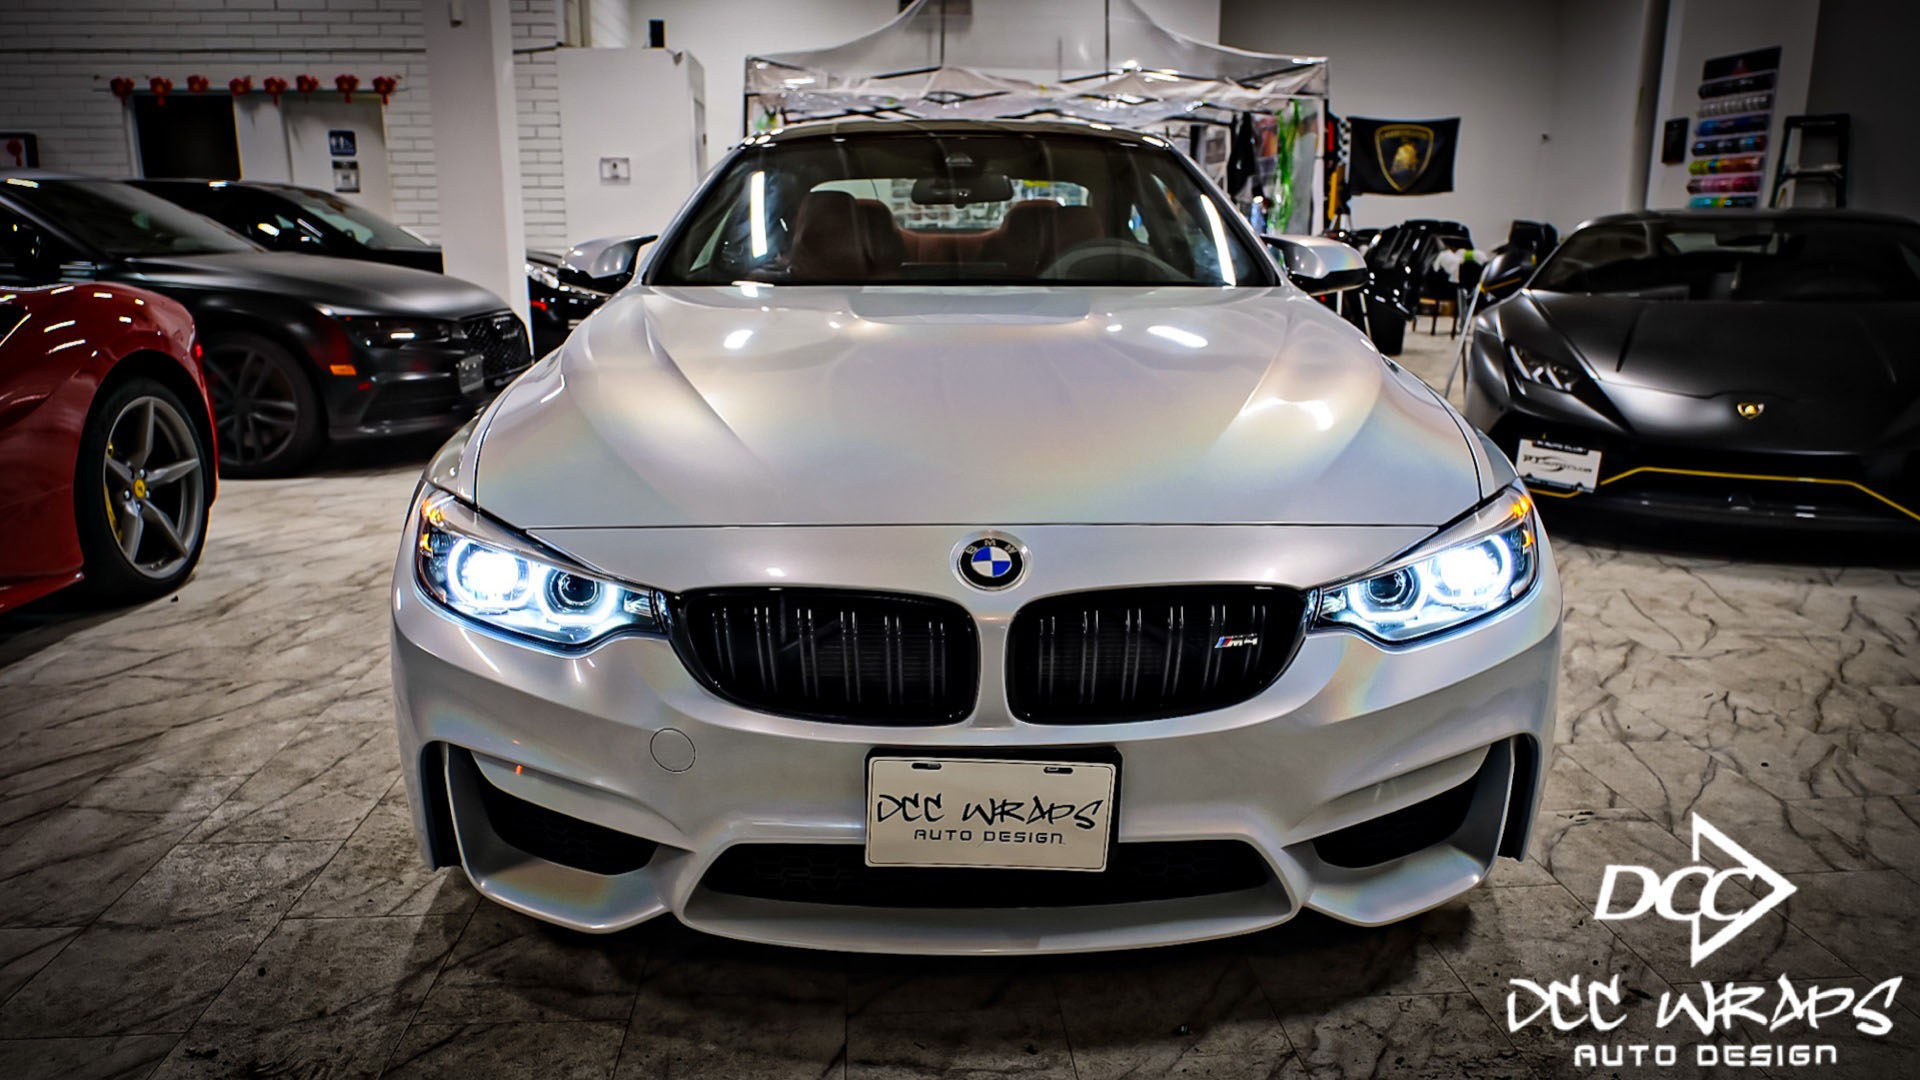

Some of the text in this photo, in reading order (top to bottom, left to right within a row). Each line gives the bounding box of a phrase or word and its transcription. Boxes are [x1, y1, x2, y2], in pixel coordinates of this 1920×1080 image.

[965, 538, 1017, 554] BMW
[1224, 637, 1258, 648] M4
[877, 793, 1104, 829] DCC WRAPS
[914, 829, 1063, 845] AUTO DESIGN
